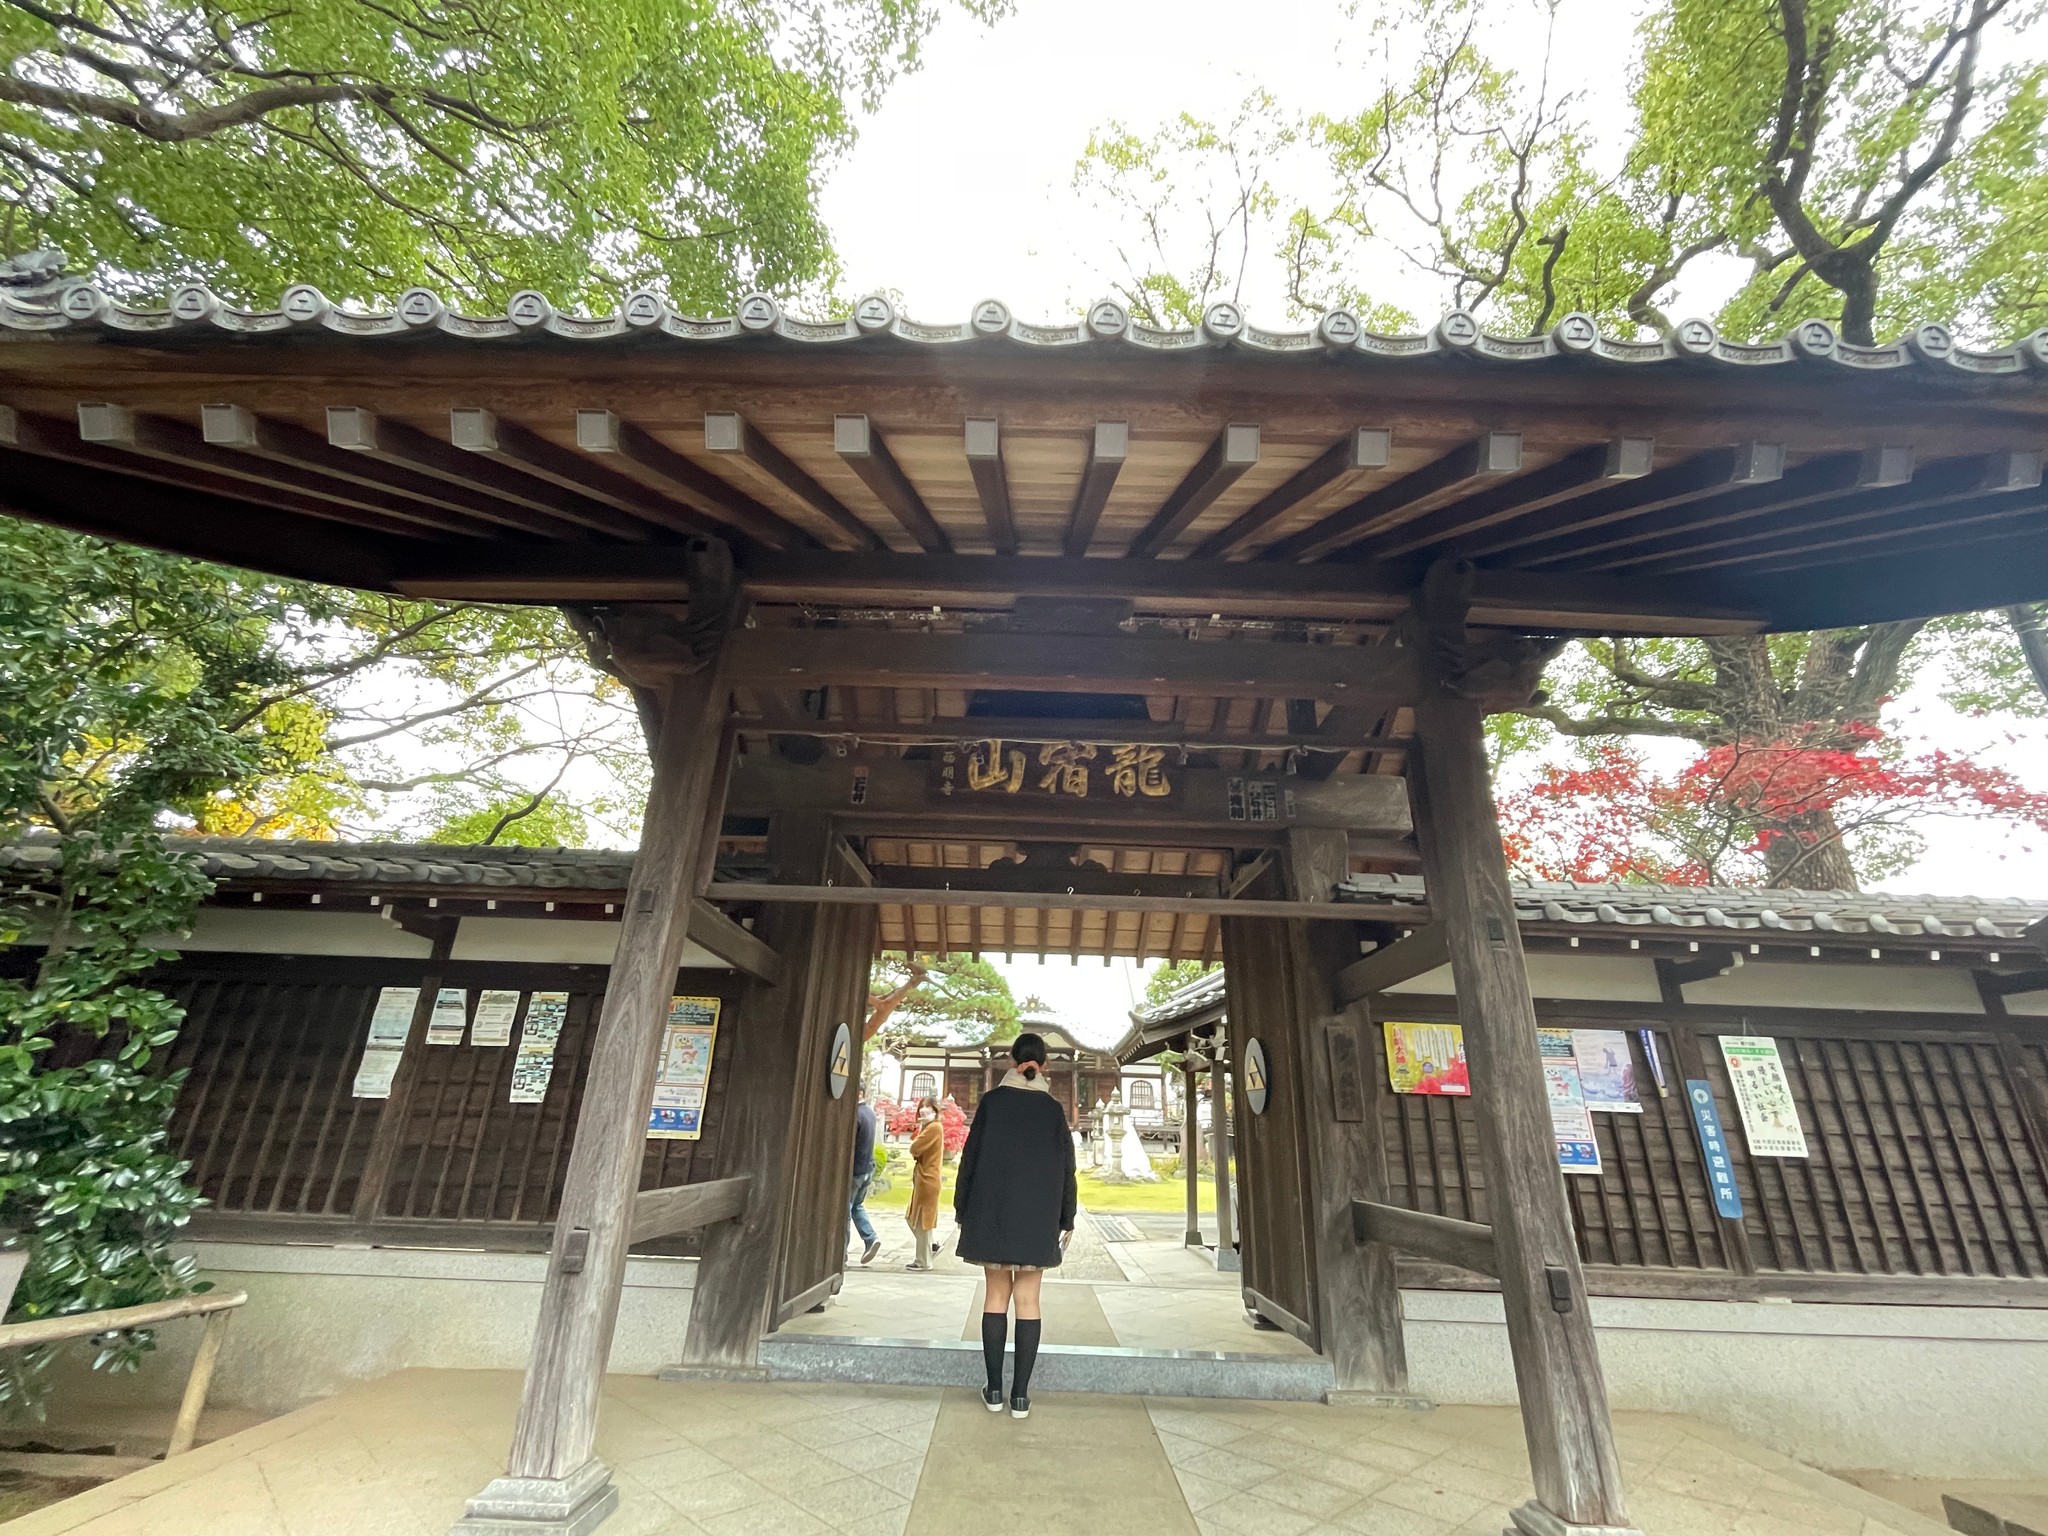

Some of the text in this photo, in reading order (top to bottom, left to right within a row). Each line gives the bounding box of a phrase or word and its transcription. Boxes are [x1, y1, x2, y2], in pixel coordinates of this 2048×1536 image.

[1700, 1109, 1733, 1200] 災害時避難所
